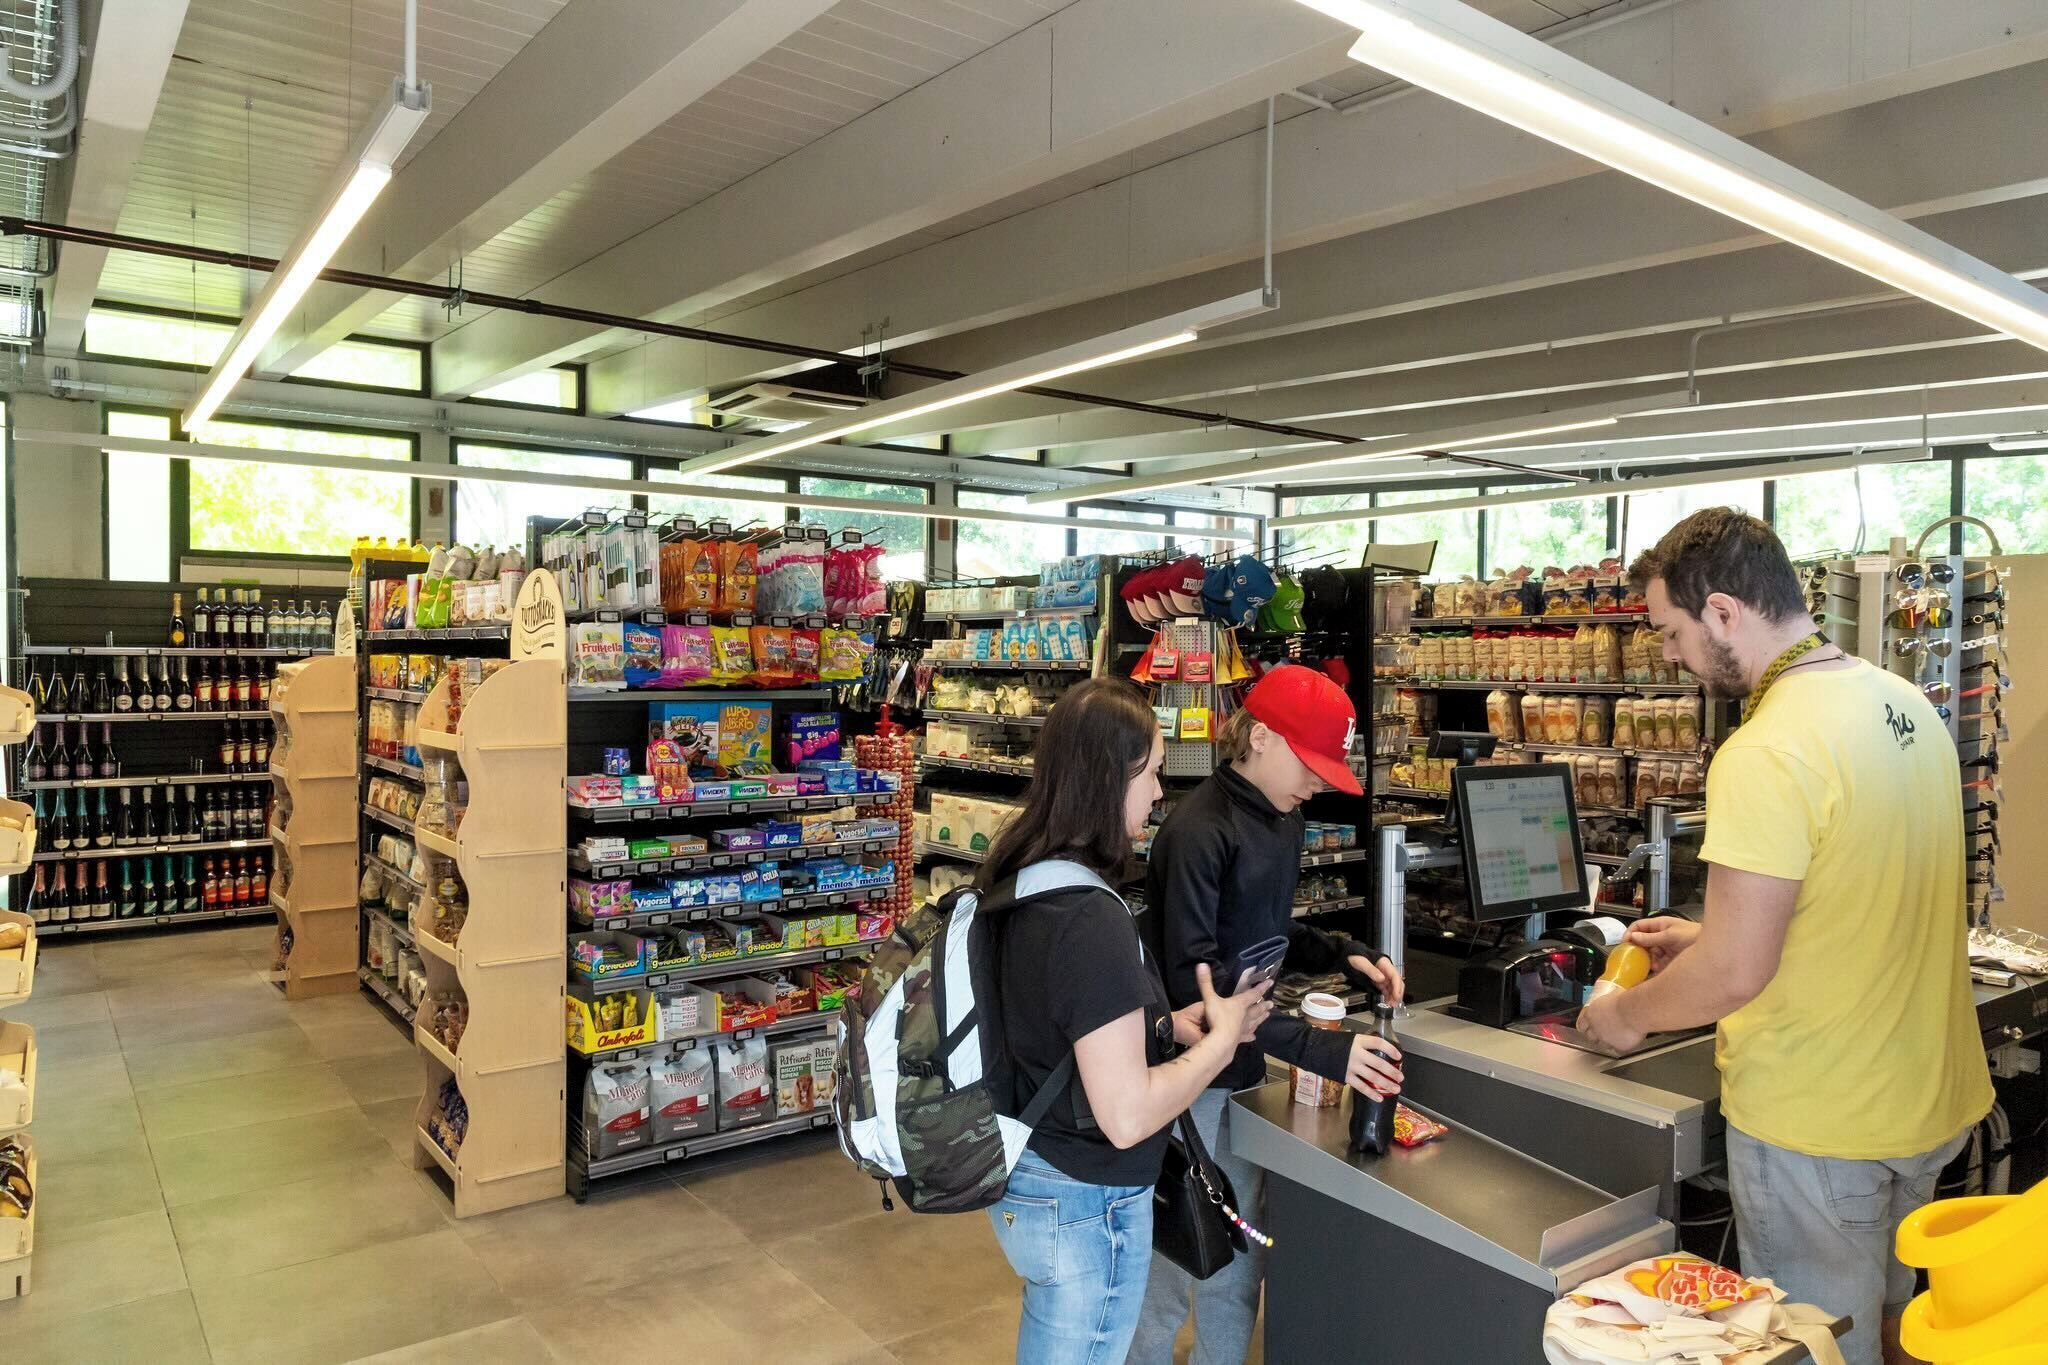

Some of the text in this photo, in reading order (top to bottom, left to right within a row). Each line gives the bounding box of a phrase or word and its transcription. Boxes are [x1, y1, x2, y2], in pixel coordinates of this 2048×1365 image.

[726, 705, 751, 717] LUPO
[674, 724, 696, 732] WEST
[723, 715, 754, 731] ALBERTO
[701, 787, 727, 796] VIVIDENT
[738, 786, 764, 795] VIVIDENT
[838, 824, 867, 840] Vigorsol
[769, 833, 788, 845] AIR
[742, 870, 759, 884] GOLIA
[762, 869, 779, 883] GOLIA
[859, 875, 890, 885] mentos
[820, 881, 853, 891] mentos
[634, 896, 671, 909] Vigorsol
[663, 1070, 697, 1085] Miglior
[682, 1073, 705, 1087] cane
